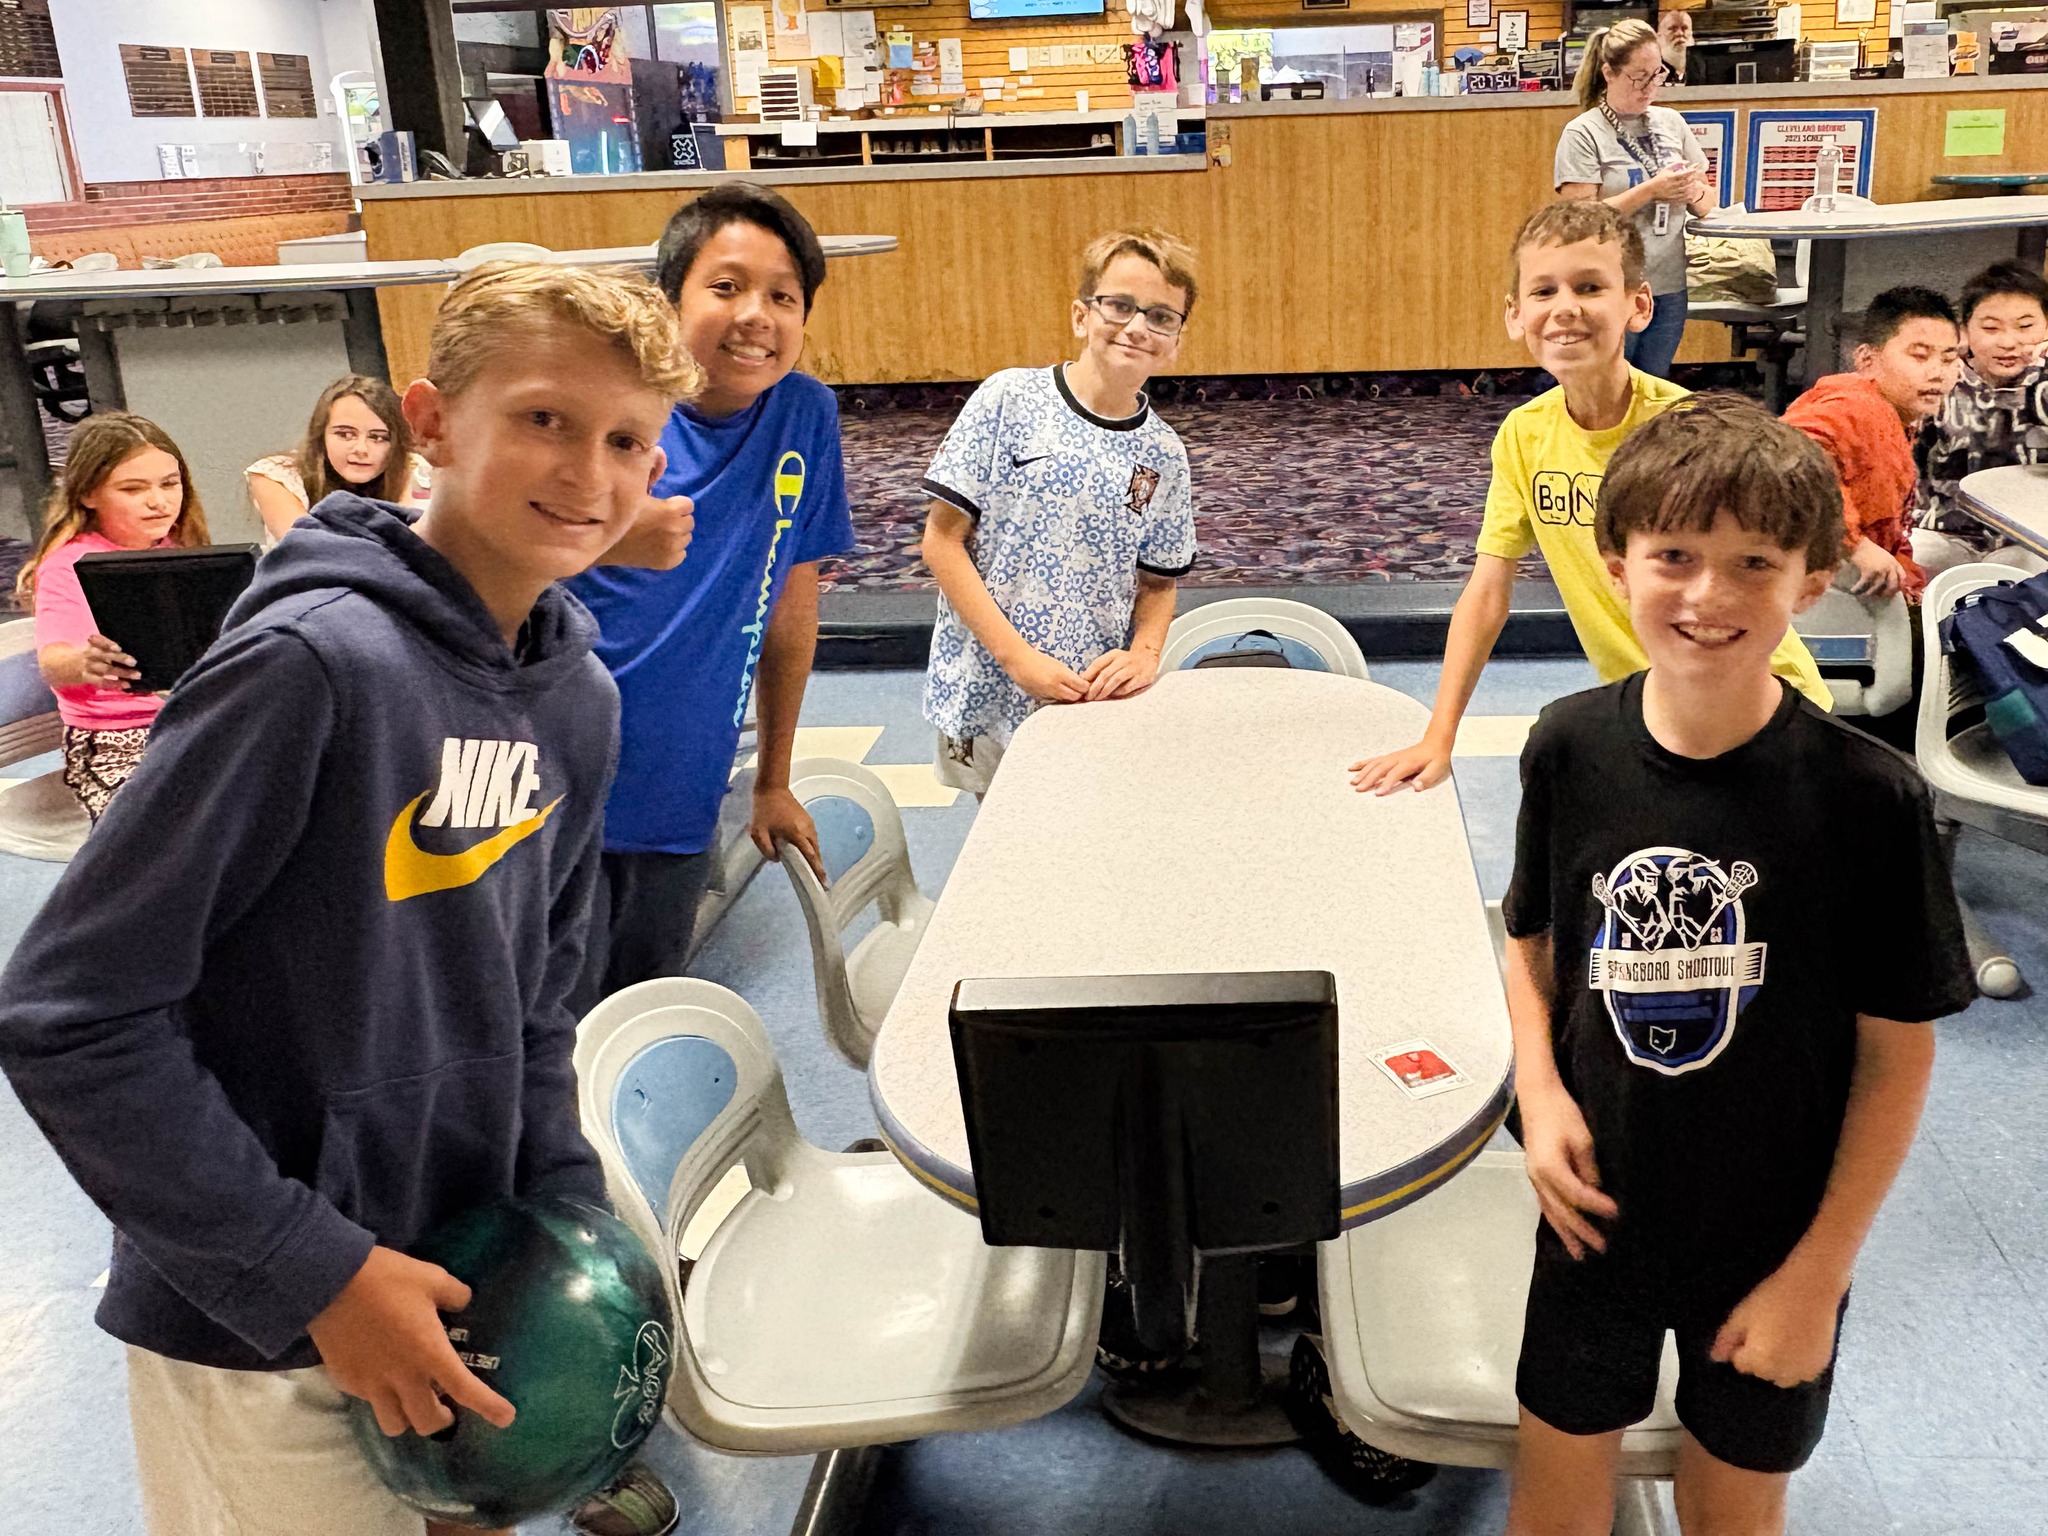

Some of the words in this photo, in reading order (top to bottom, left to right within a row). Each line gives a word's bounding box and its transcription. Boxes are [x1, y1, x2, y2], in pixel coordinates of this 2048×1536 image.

[733, 450, 806, 728] Champion
[419, 737, 541, 828] NIKE
[1677, 956, 1736, 980] SHOOTOUT
